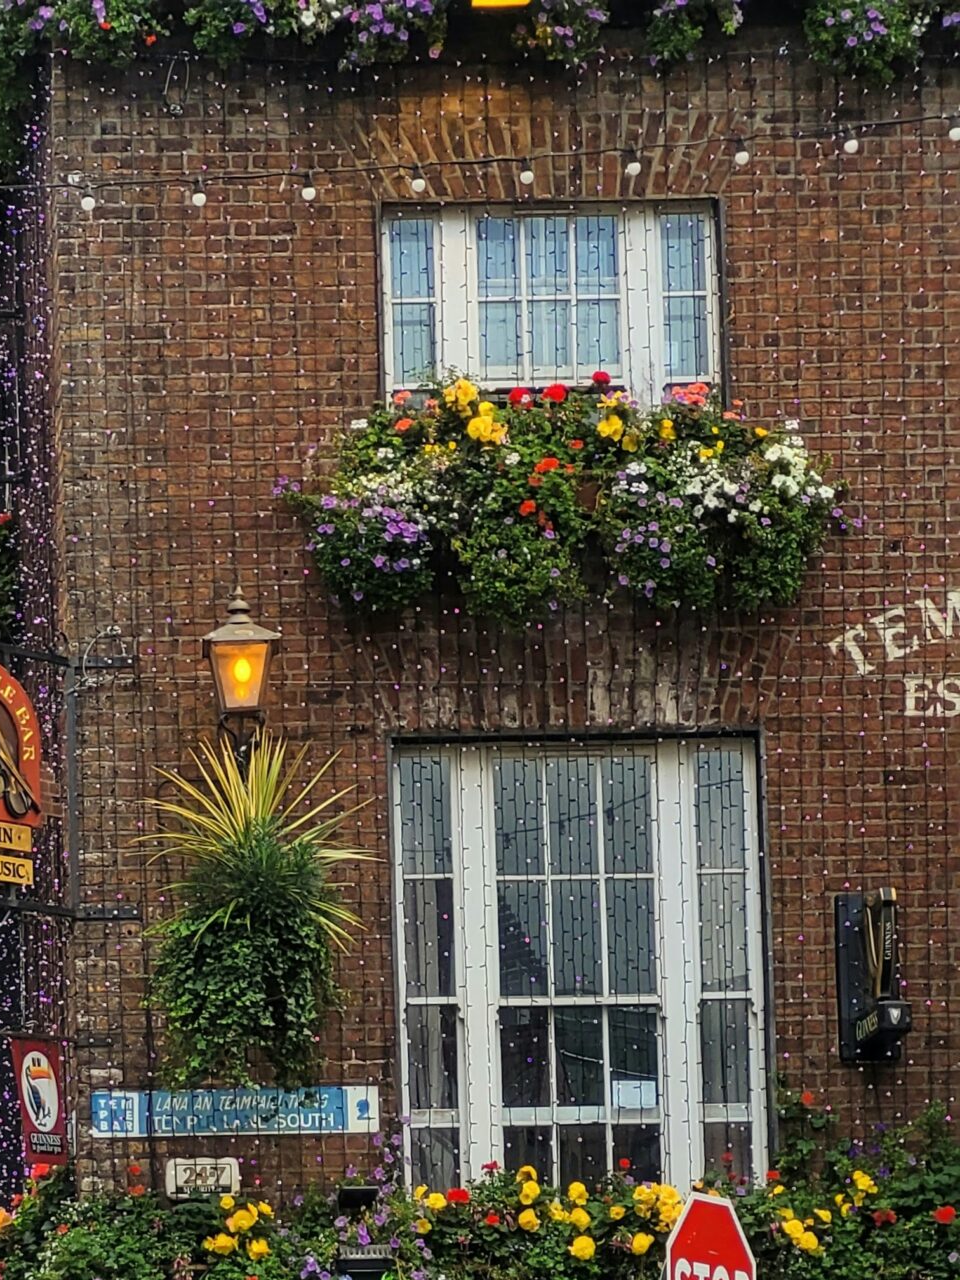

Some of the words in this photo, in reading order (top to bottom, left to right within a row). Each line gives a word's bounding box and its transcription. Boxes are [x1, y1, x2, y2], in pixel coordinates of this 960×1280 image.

[16, 707, 35, 760] BAR
[884, 922, 892, 960] GUINNESS
[156, 1095, 188, 1112] LANA
[194, 1095, 213, 1111] AN
[99, 1121, 133, 1132] BAR
[274, 1112, 335, 1129] SOUTH
